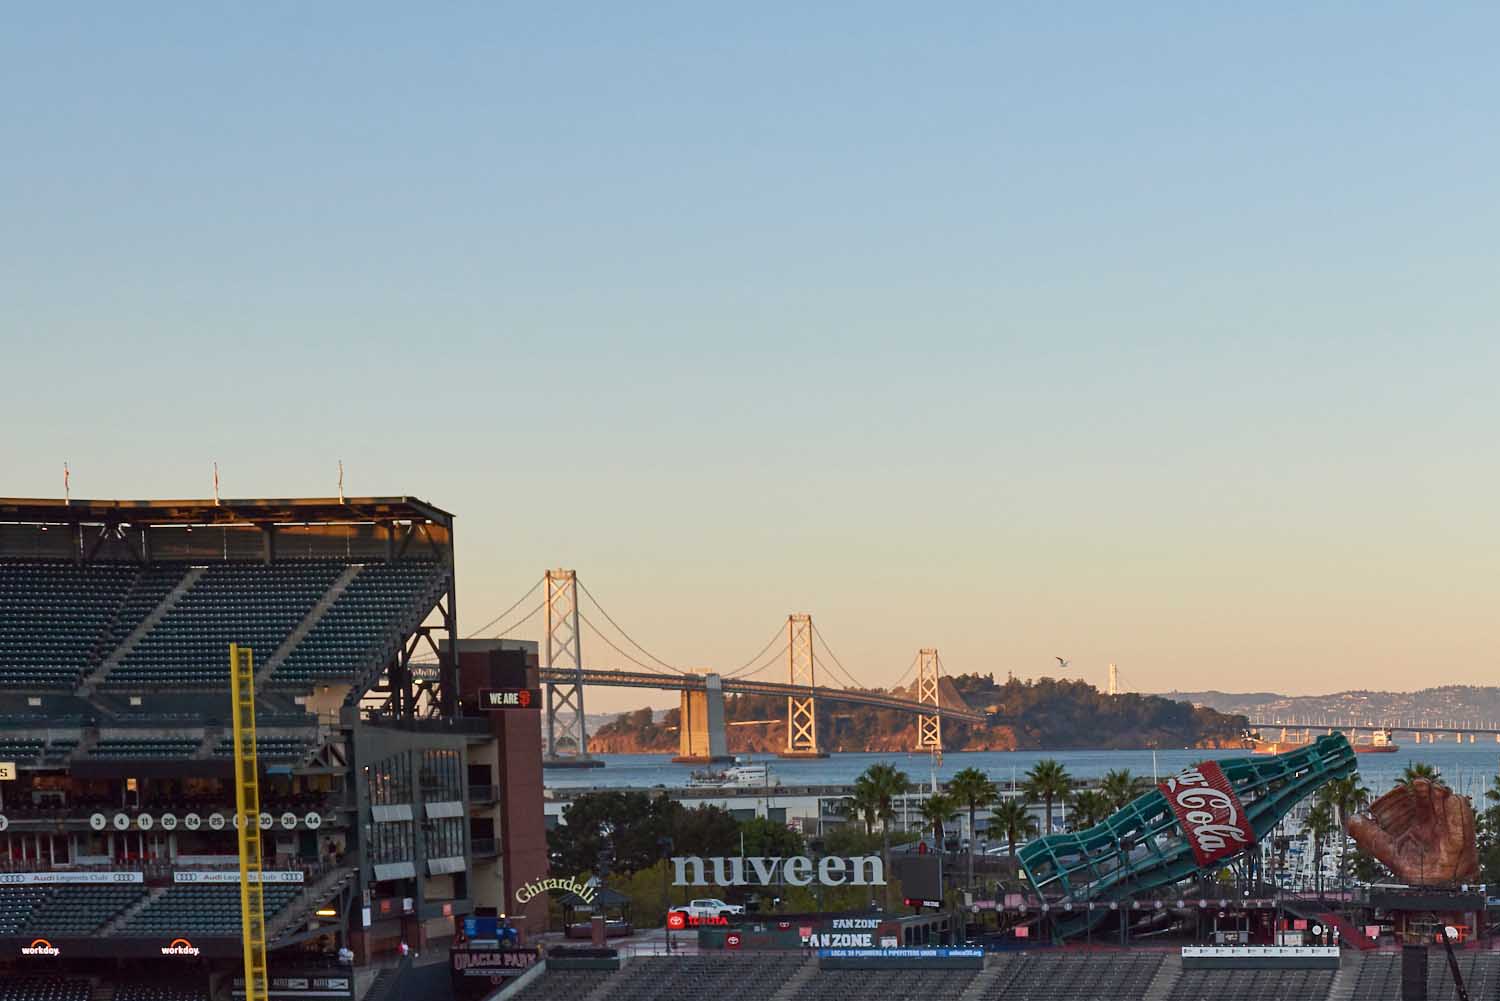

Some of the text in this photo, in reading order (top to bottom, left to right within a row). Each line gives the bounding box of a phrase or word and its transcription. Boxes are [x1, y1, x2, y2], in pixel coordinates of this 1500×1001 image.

[490, 692, 502, 704] WE
[503, 692, 519, 704] ARE
[670, 855, 887, 887] nuveen
[515, 876, 599, 904] Ghirardelli
[688, 916, 728, 926] TOYOTA
[830, 933, 873, 947] ZONE
